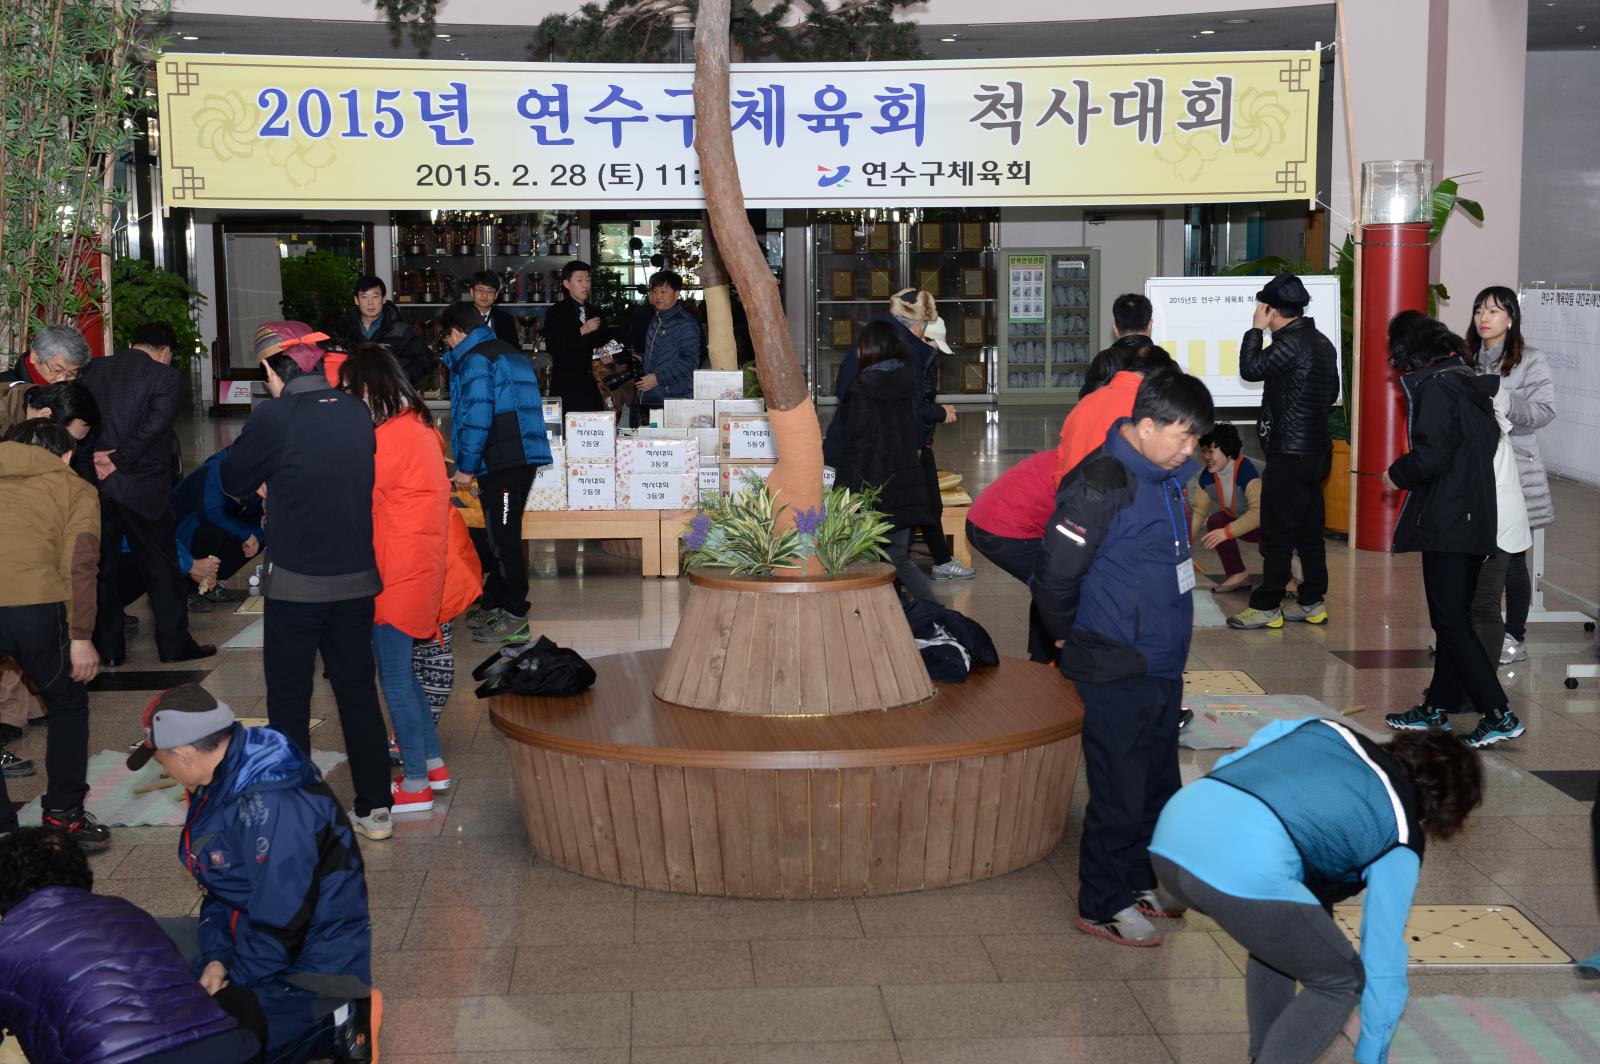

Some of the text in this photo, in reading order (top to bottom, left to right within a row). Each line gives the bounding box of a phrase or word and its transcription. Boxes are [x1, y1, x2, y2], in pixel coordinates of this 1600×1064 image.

[258, 82, 474, 146] 2015년
[969, 76, 1233, 147] 척사대회
[416, 163, 700, 192] 2015. 2. 28 (토) 11:
[862, 159, 1031, 187] 연수구체육회
[1169, 296, 1198, 304] 2015년도
[1201, 296, 1221, 304] 연수구
